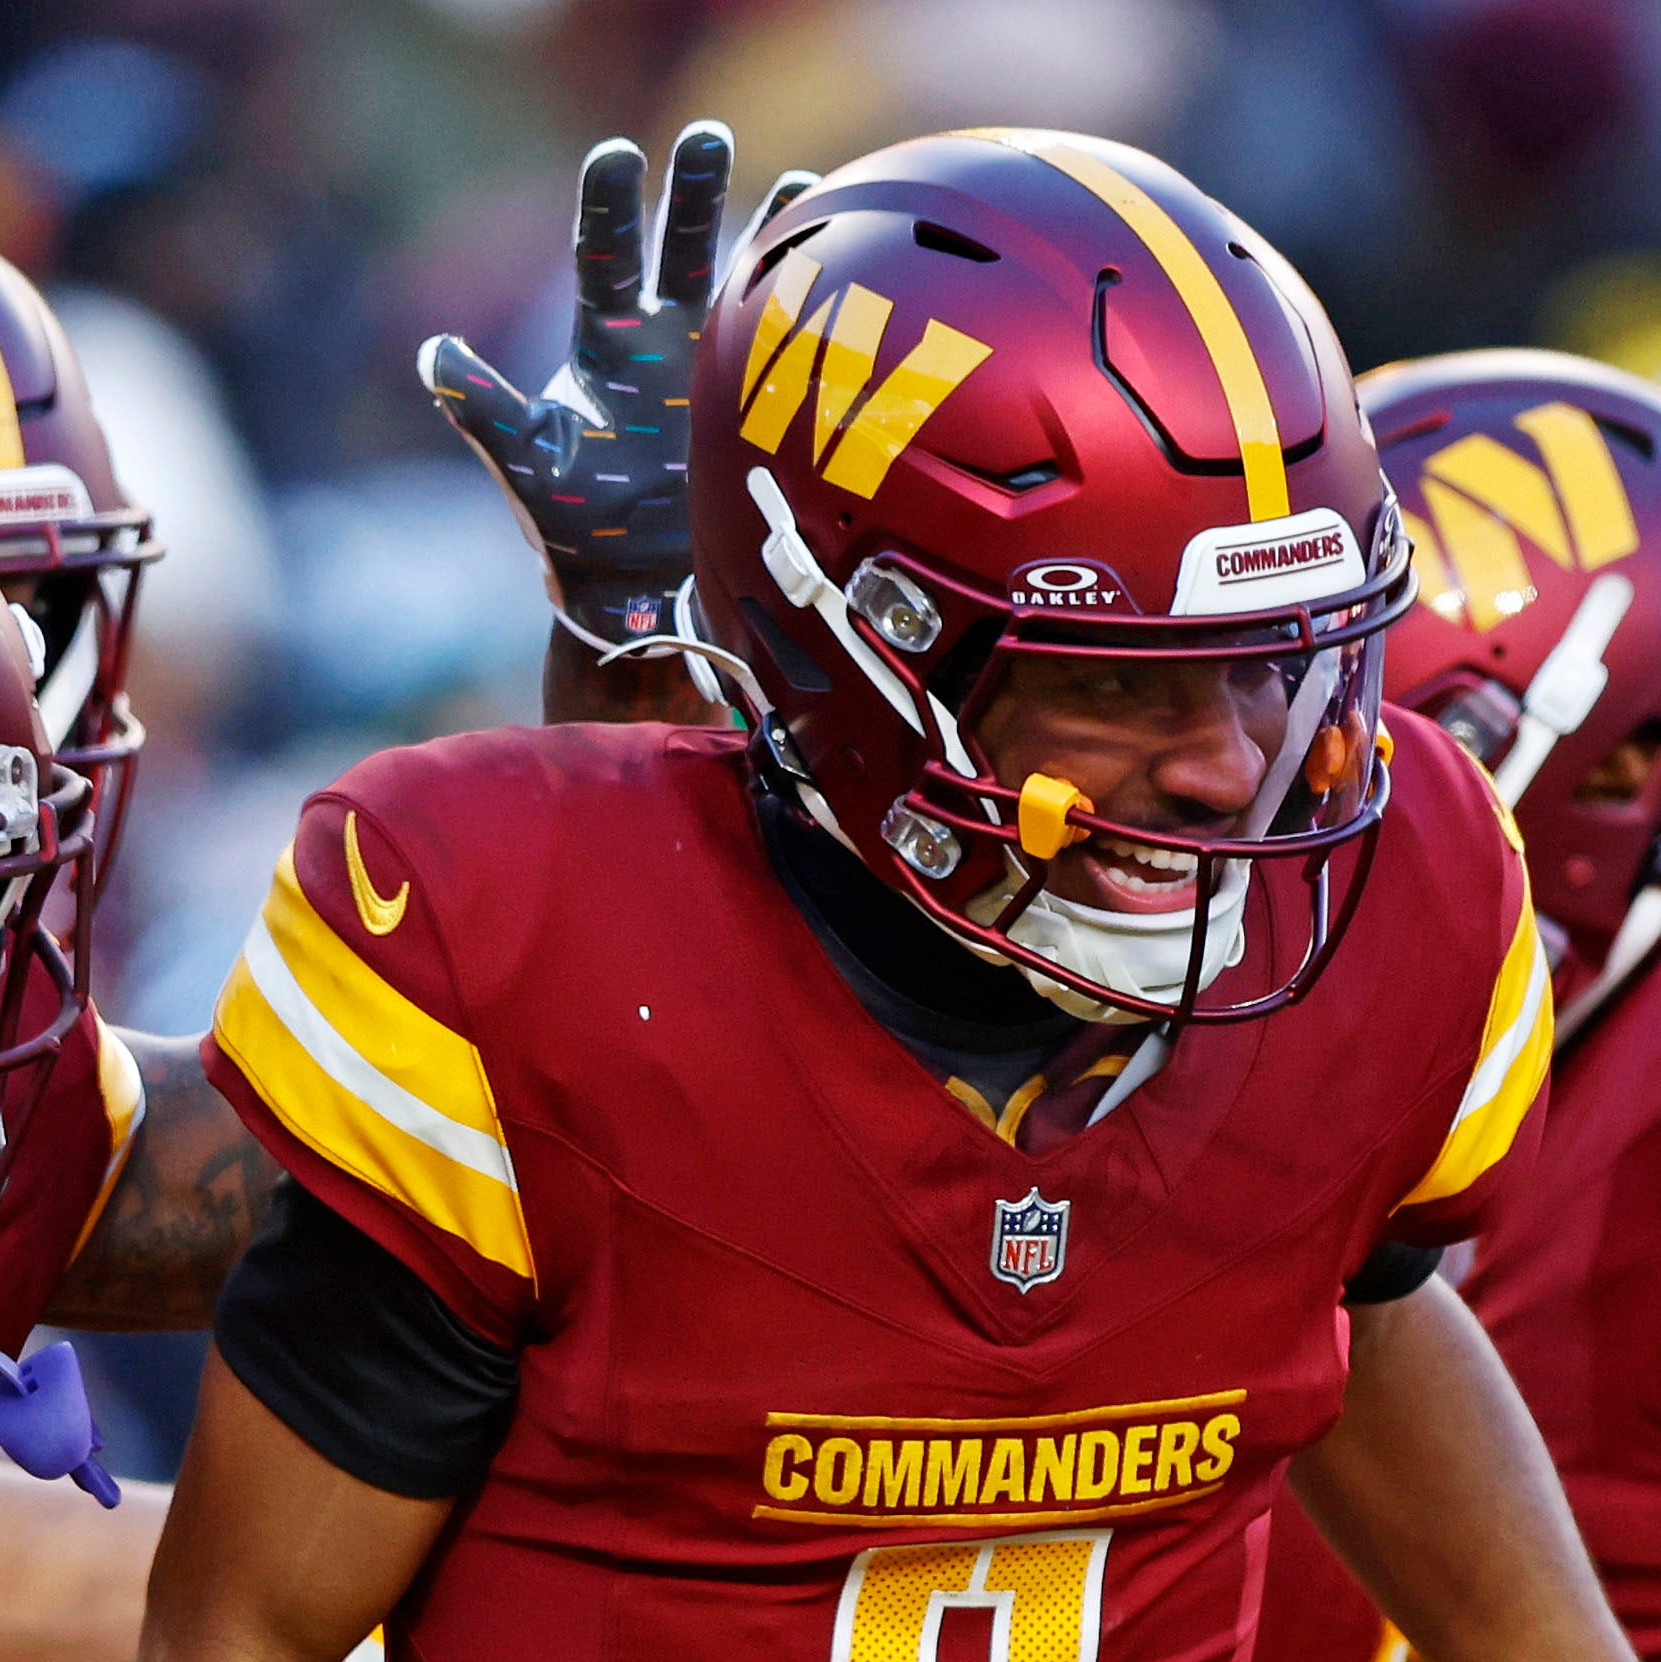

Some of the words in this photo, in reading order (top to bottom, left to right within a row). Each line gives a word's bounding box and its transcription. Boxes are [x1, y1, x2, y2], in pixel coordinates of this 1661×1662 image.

[1215, 532, 1345, 578] COMMANDERS
[1011, 591, 1118, 606] OAKLEY
[1003, 1239, 1054, 1275] NFL
[763, 1412, 1242, 1510] COMMANDERS
